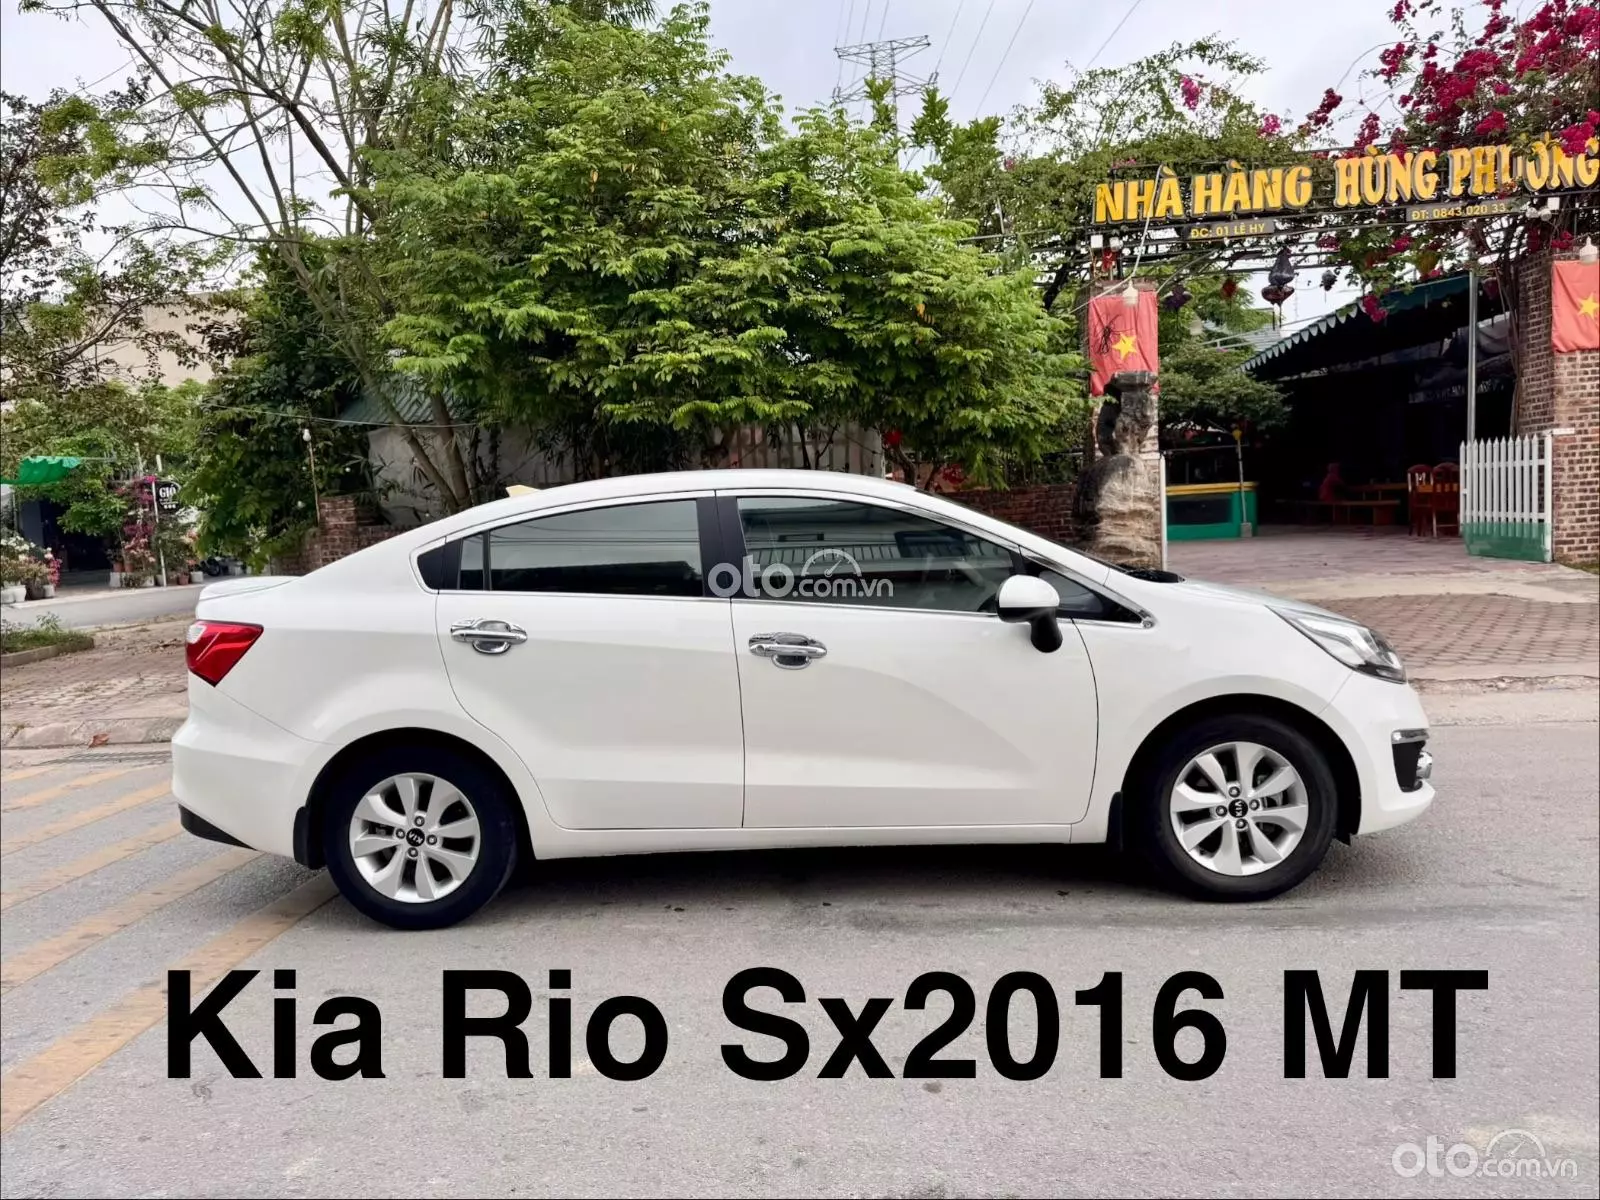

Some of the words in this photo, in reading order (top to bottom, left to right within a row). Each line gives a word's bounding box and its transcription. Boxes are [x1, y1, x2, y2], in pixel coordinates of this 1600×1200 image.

[1095, 165, 1184, 222] NHÀ
[1193, 159, 1312, 215] HÀNG
[1335, 144, 1440, 207] HÙNG
[1466, 205, 1488, 215] 020
[1216, 226, 1229, 236] 01
